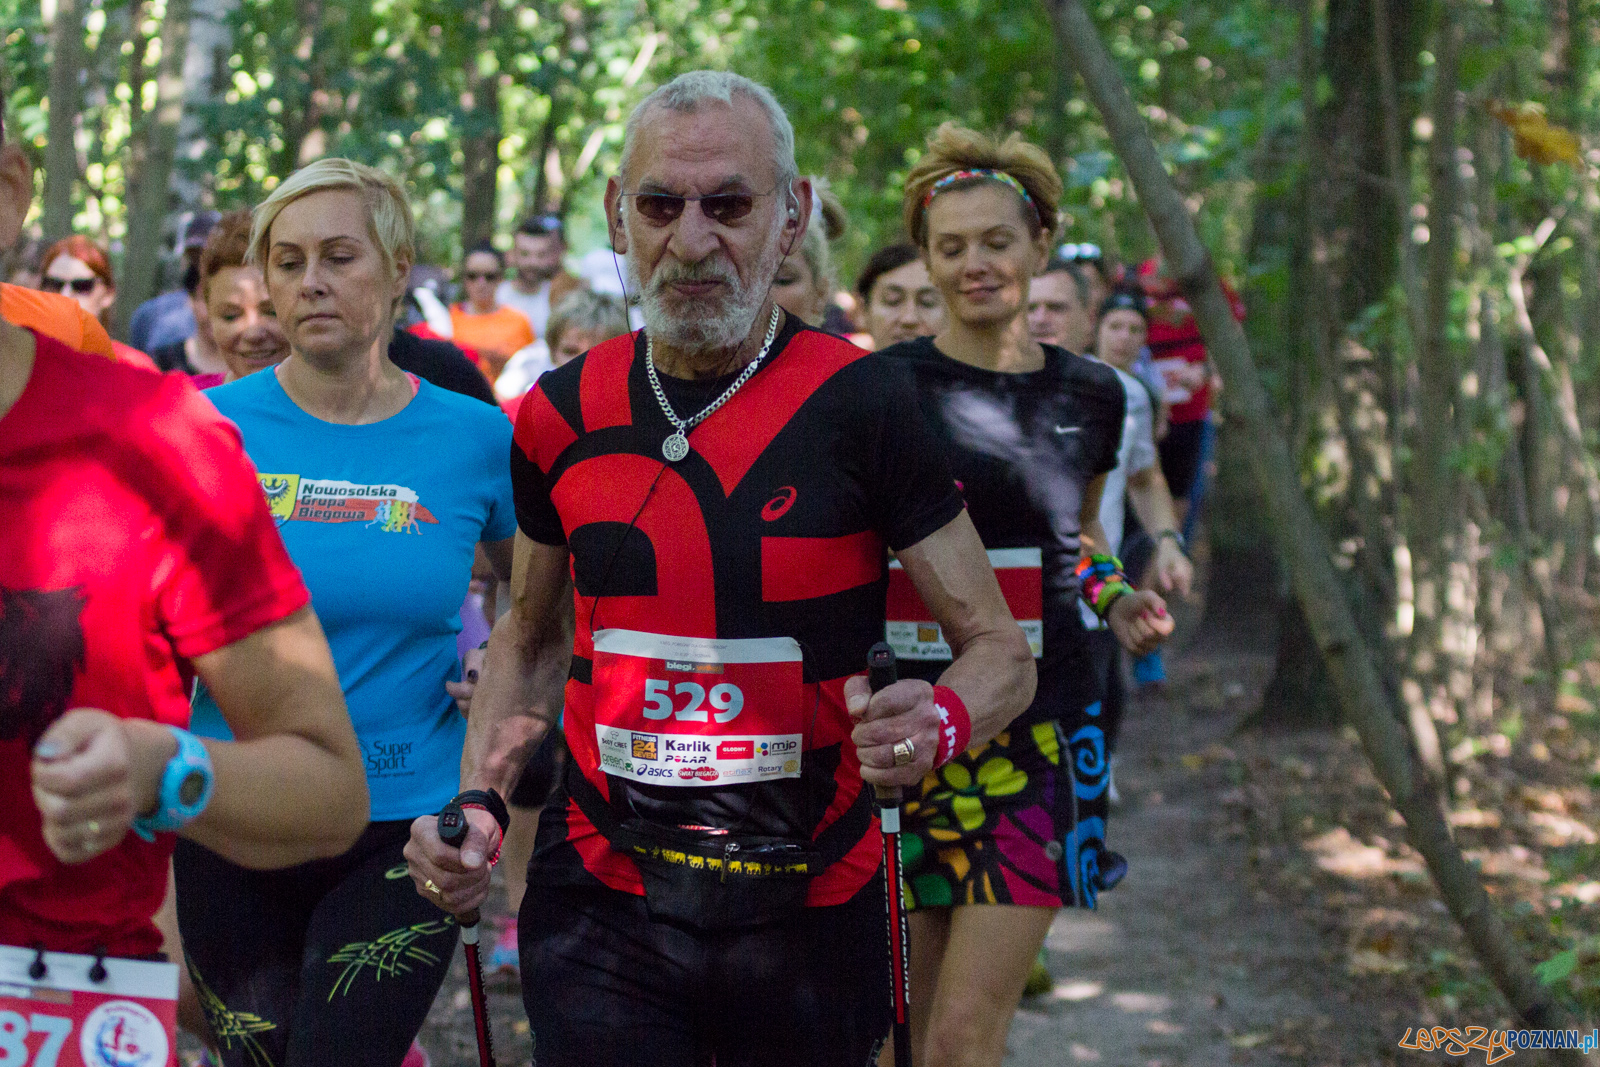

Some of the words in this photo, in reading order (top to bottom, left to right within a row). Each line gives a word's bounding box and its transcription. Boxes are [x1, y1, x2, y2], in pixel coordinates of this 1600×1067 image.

[302, 483, 397, 497] Nowosolska
[300, 495, 346, 508] Grupa
[298, 507, 366, 521] Biegowa
[642, 678, 744, 724] 529
[373, 740, 413, 758] Super
[632, 740, 657, 753] 24
[665, 739, 712, 752] Karlik
[771, 740, 798, 752] mjp
[632, 750, 657, 760] SEVEN
[367, 754, 407, 774] Sport
[757, 764, 783, 774] Rotary
